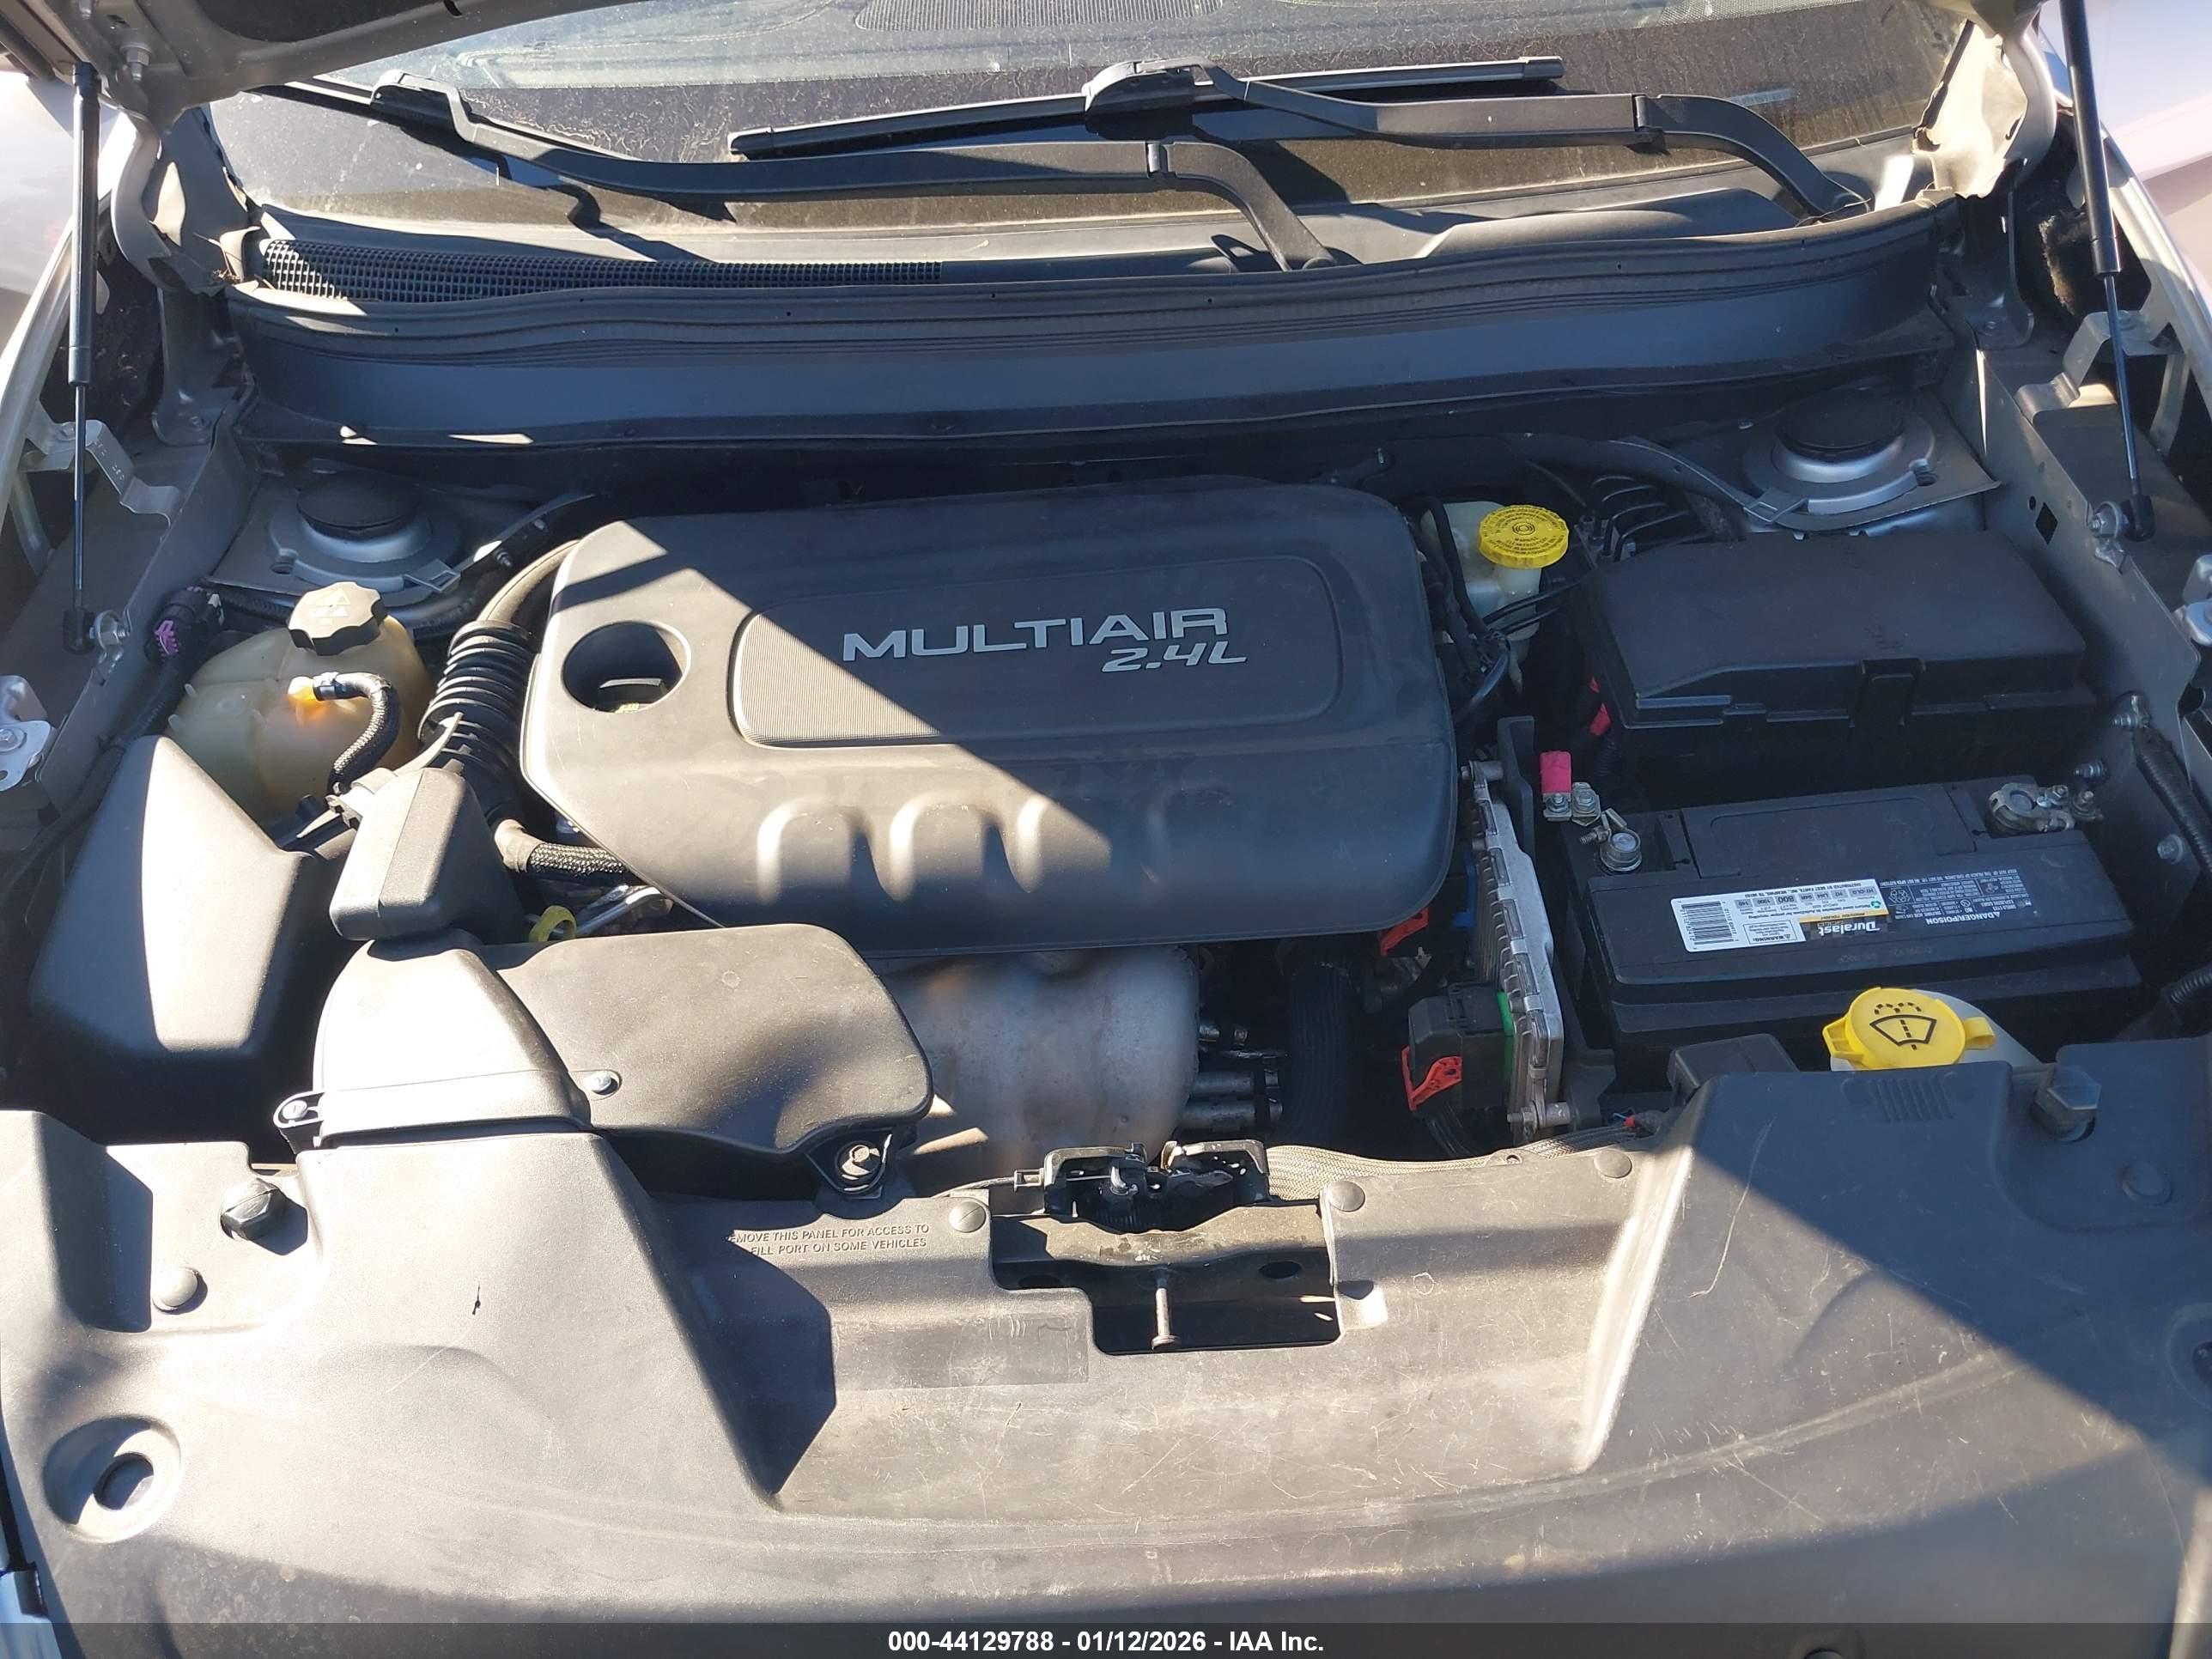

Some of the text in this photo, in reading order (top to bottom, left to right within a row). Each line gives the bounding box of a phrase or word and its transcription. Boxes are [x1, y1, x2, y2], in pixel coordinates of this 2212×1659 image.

[842, 607, 1228, 662] MULTIAIR
[1102, 641, 1248, 673] 2.4L
[1818, 921, 1881, 936] Duralast
[773, 1231, 799, 1241] THIS
[802, 1229, 838, 1240] PANEL
[842, 1228, 865, 1238] FOR
[866, 1225, 912, 1237] ACCESS
[915, 1224, 930, 1234] TO
[778, 1244, 809, 1255] PORT
[812, 1243, 830, 1253] ON
[833, 1241, 867, 1251] SOME
[871, 1238, 927, 1249] VEHICLES
